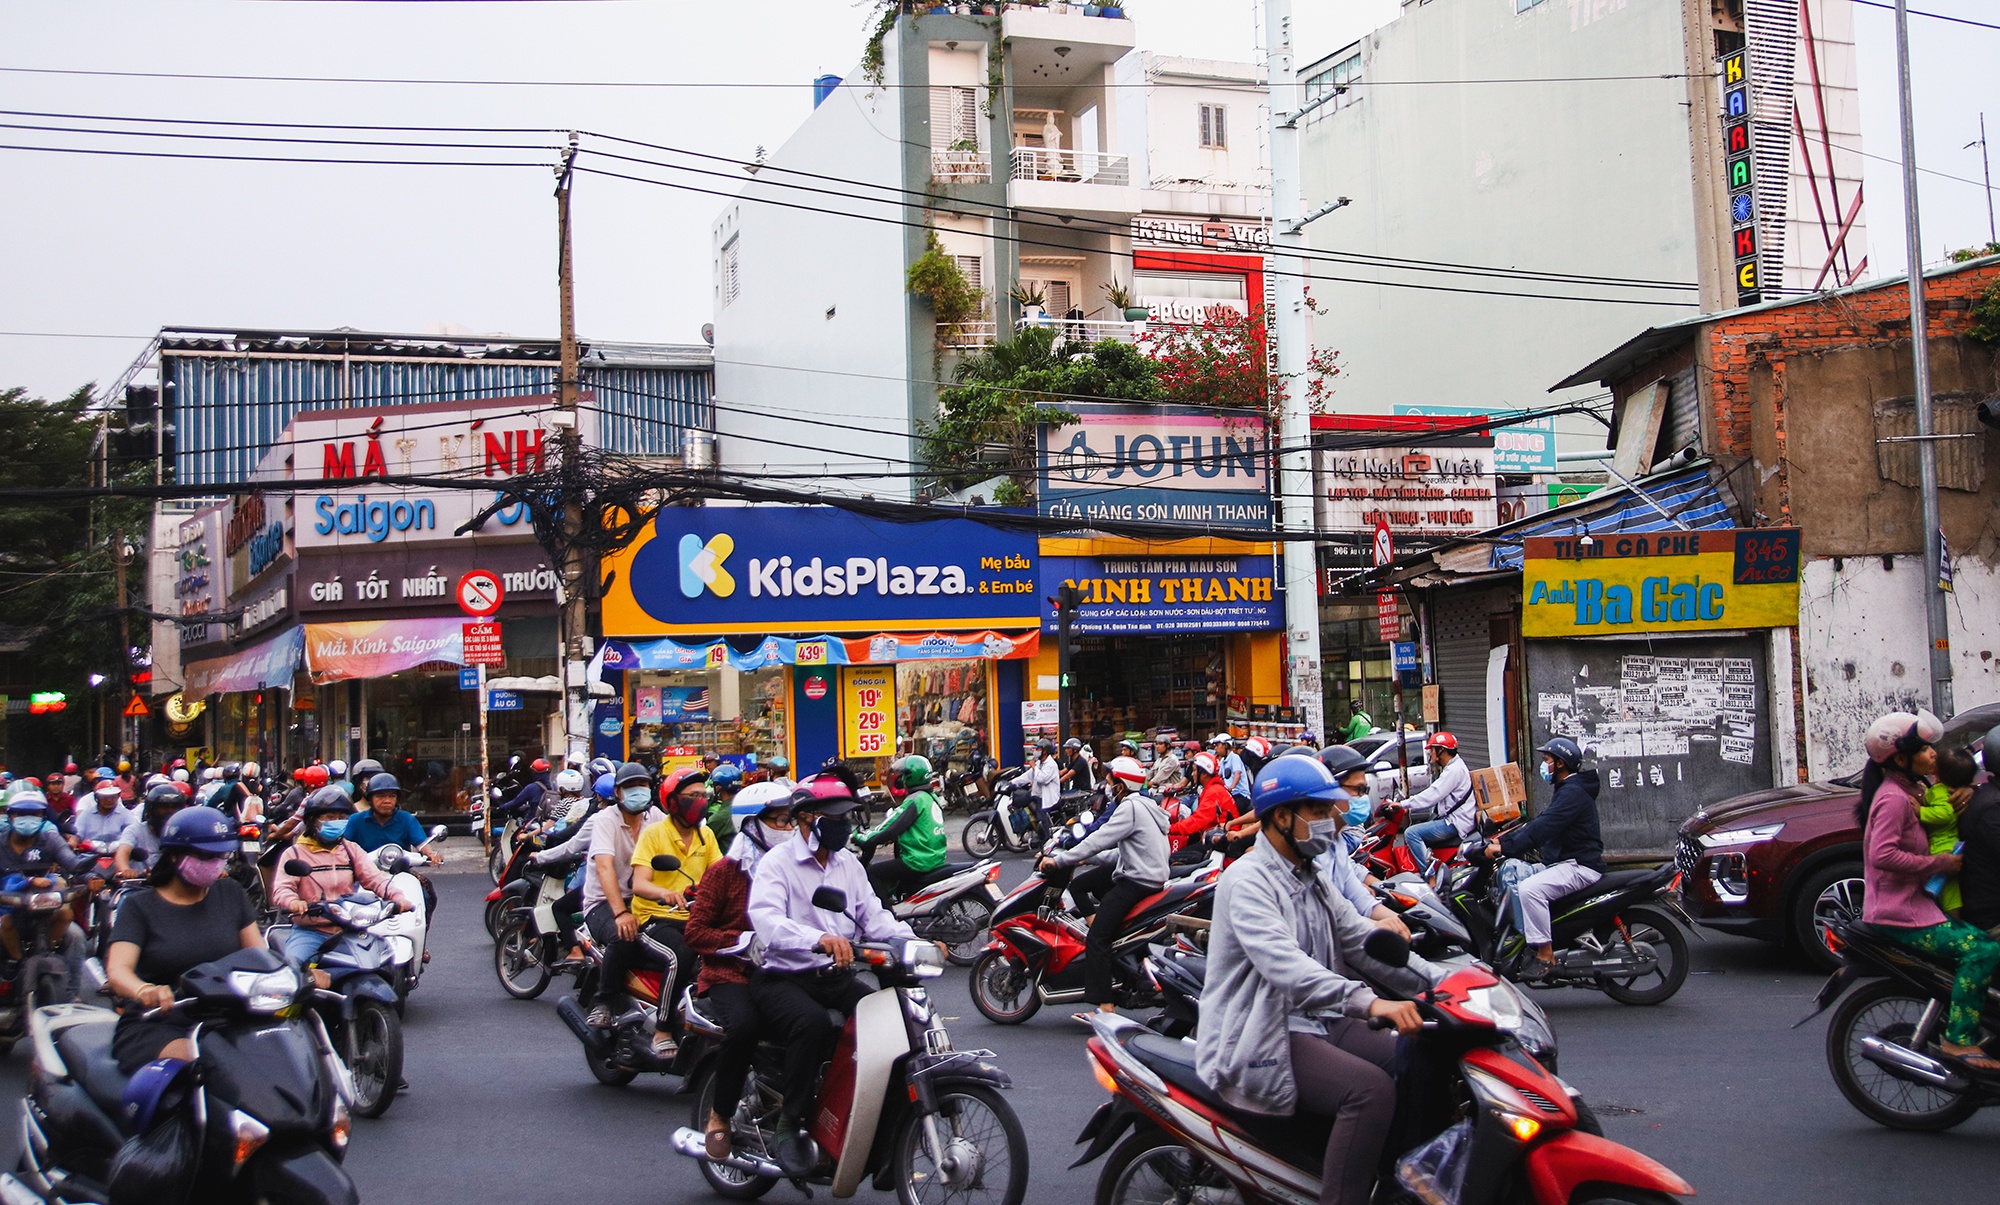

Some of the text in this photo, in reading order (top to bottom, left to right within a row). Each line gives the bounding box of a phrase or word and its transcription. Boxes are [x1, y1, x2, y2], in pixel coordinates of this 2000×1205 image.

[1493, 432, 1546, 453] ONG
[1106, 434, 1256, 479] JOTUN
[315, 494, 435, 543] Saigon
[1087, 501, 1132, 520] HÀNG
[1137, 503, 1168, 520] SƠN
[1173, 505, 1212, 520] MINH
[1216, 504, 1268, 520] THANH
[1334, 546, 1348, 555] 906
[1744, 537, 1787, 562] 845
[981, 553, 1031, 573] Mẹ bầu
[1104, 561, 1138, 574] TRUNG
[1165, 561, 1187, 573] PHA
[311, 565, 448, 601] GIÁ TỐT NHẤT
[979, 579, 1034, 594] & Em bé
[1159, 577, 1273, 603] THANH
[1529, 580, 1575, 605] Anh
[1574, 578, 1633, 626] Ba
[182, 624, 206, 642] GUCCI
[922, 636, 958, 648] moony
[317, 635, 388, 658] Mắt Kính
[858, 689, 882, 708] 19k
[859, 712, 885, 730] 29k
[859, 734, 886, 752] 55k
